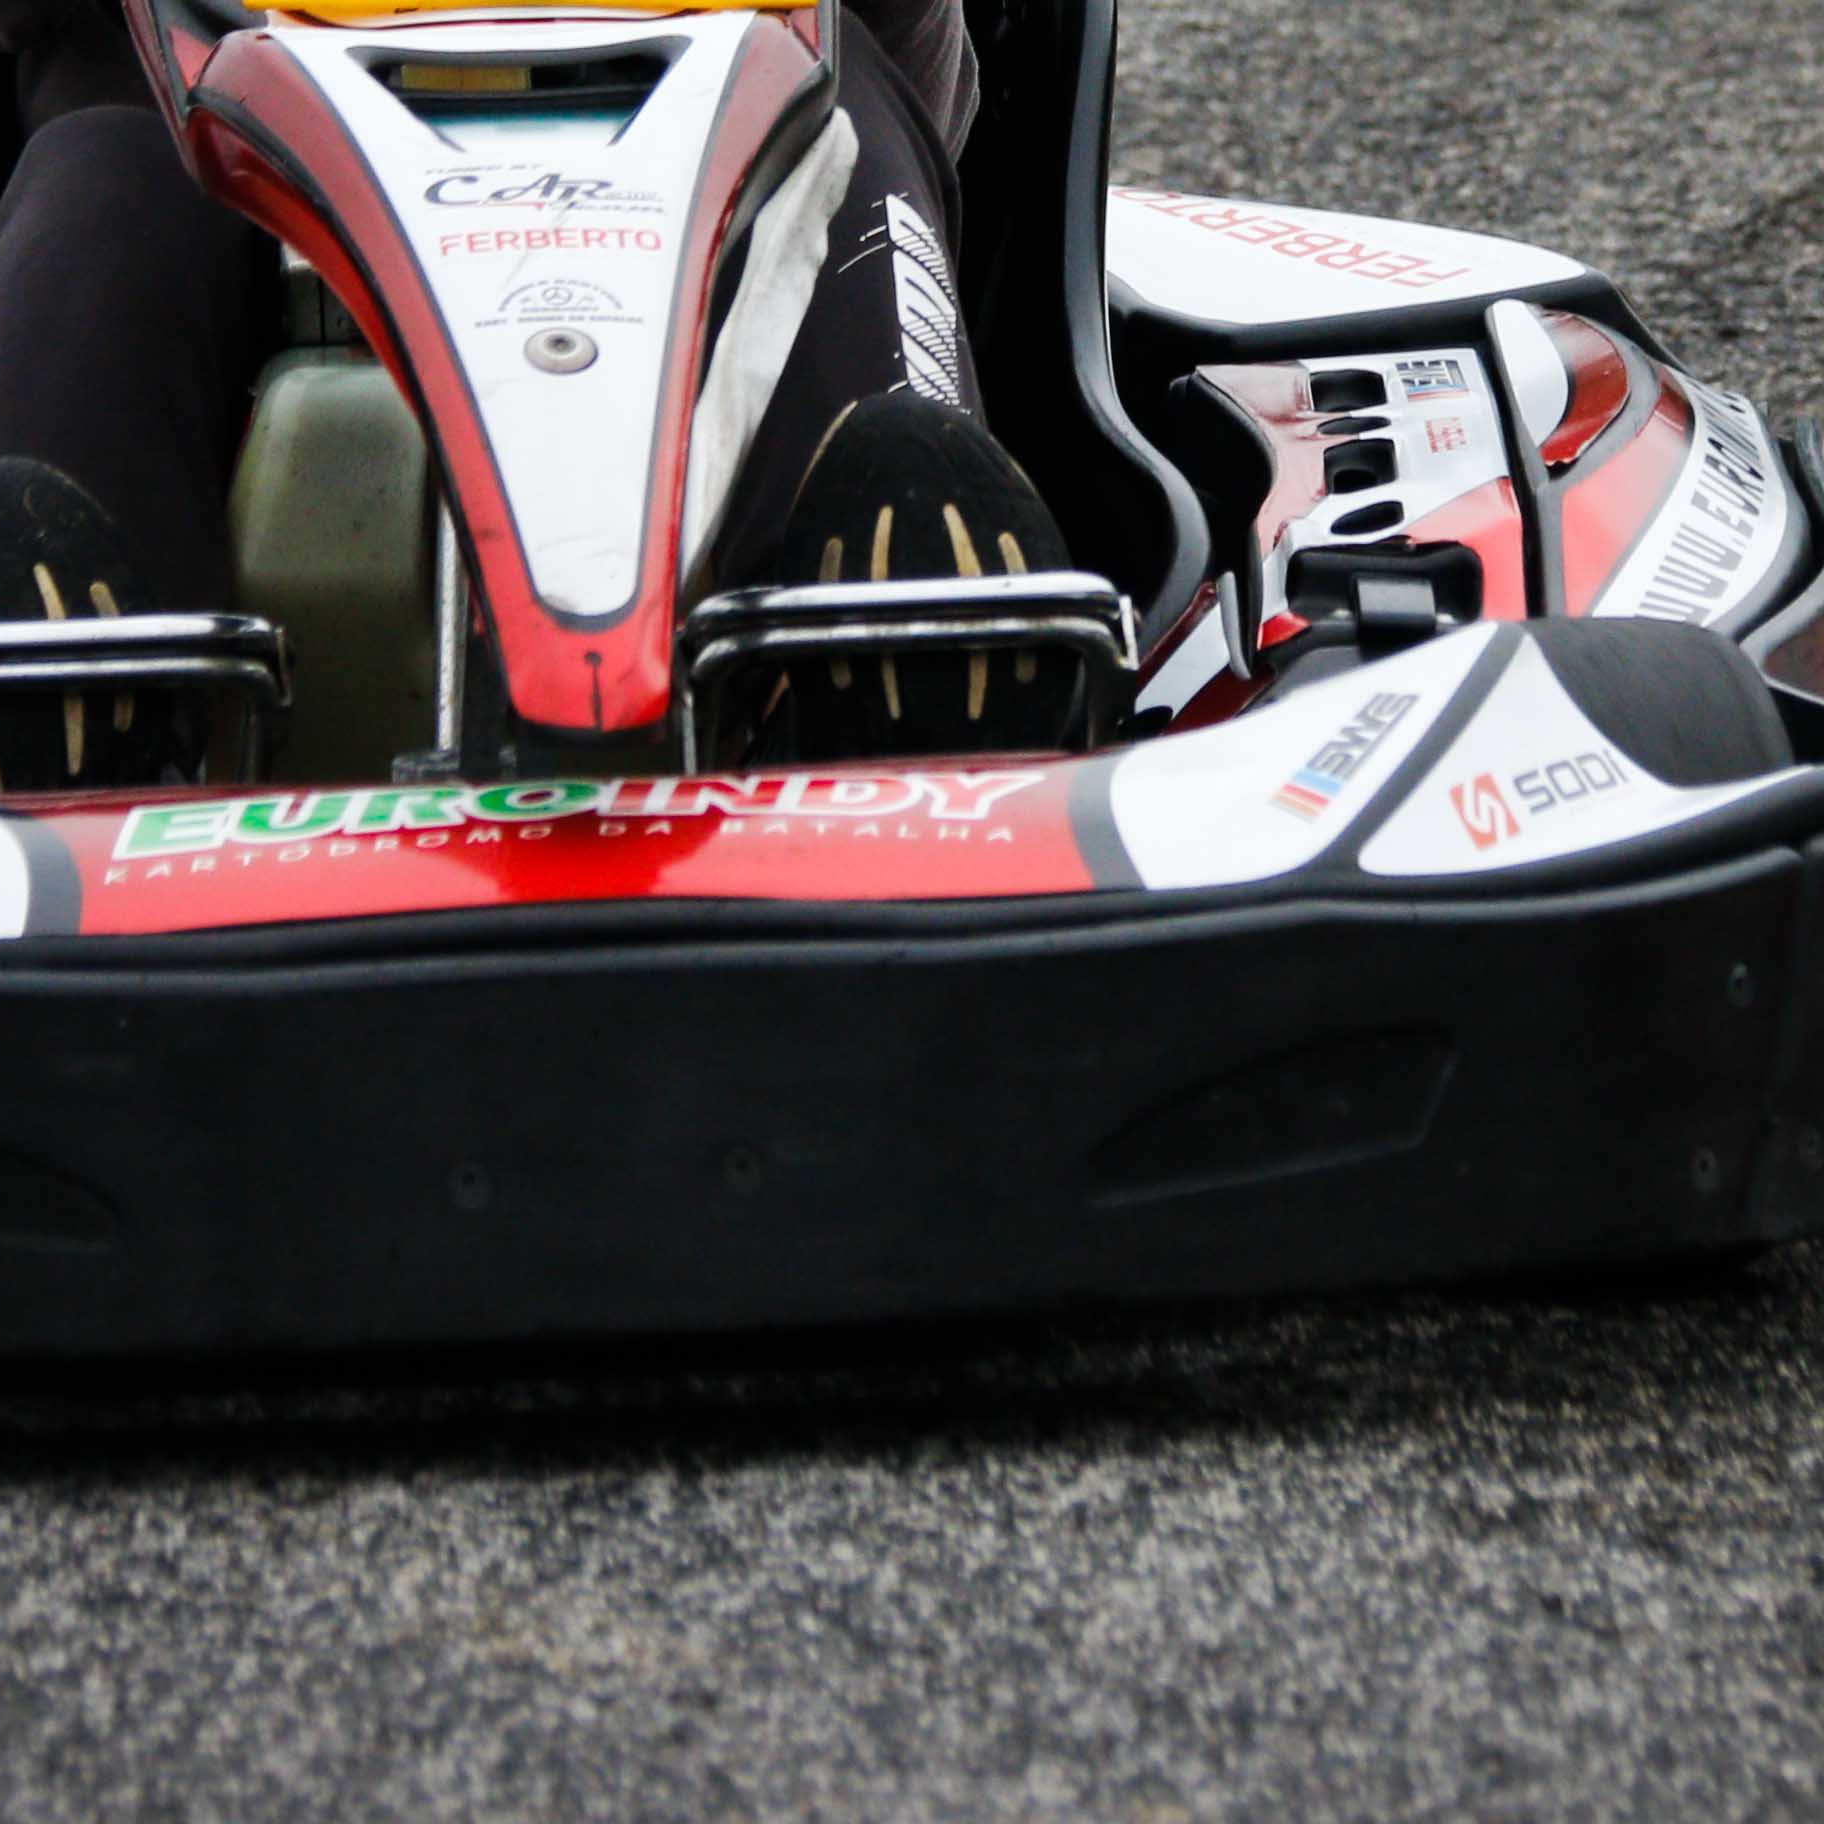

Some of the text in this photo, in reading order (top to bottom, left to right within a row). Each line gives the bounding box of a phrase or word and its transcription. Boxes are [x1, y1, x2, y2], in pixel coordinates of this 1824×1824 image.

[439, 228, 663, 256] FERBERTO
[1112, 187, 1470, 288] FERBERTO
[1514, 748, 1629, 814] SODI
[112, 774, 1046, 860] EUROINDY
[105, 820, 1014, 886] KARTODROMO DA BATALHA
